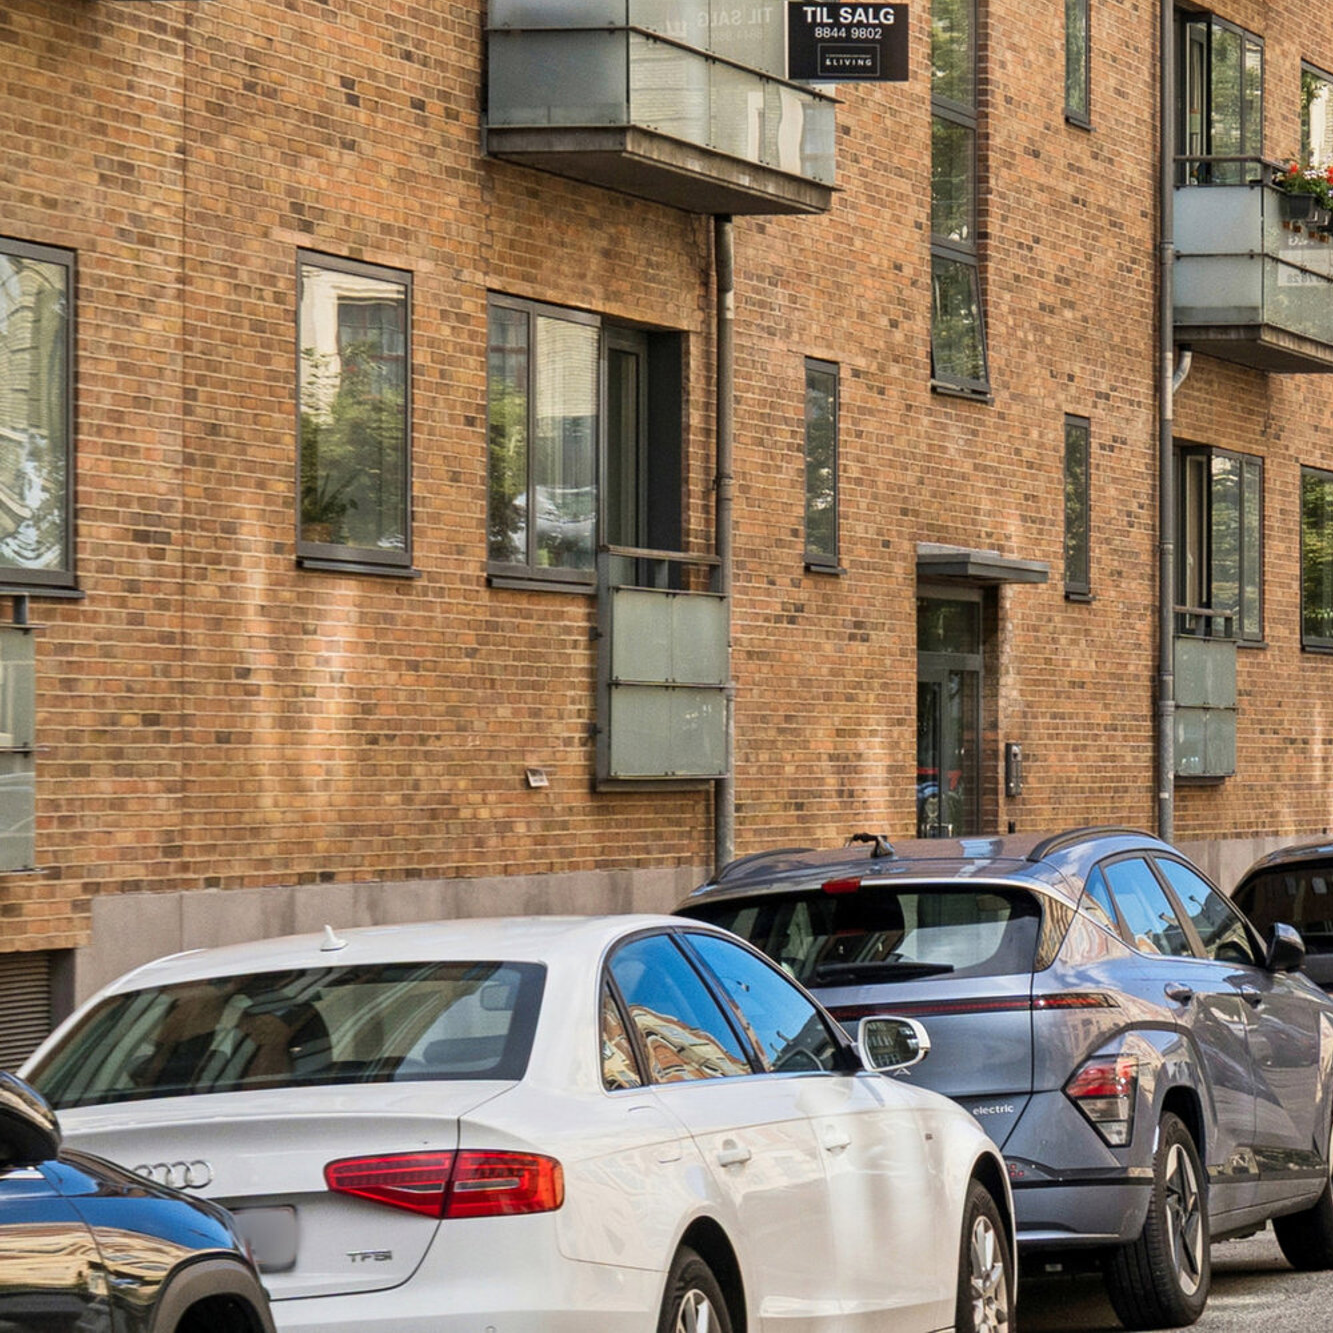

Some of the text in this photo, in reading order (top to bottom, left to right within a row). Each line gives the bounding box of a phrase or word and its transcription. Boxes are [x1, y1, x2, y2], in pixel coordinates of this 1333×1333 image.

[803, 6, 895, 25] TIL SALG
[815, 26, 882, 40] 8844 9802
[972, 1104, 1014, 1116] electric
